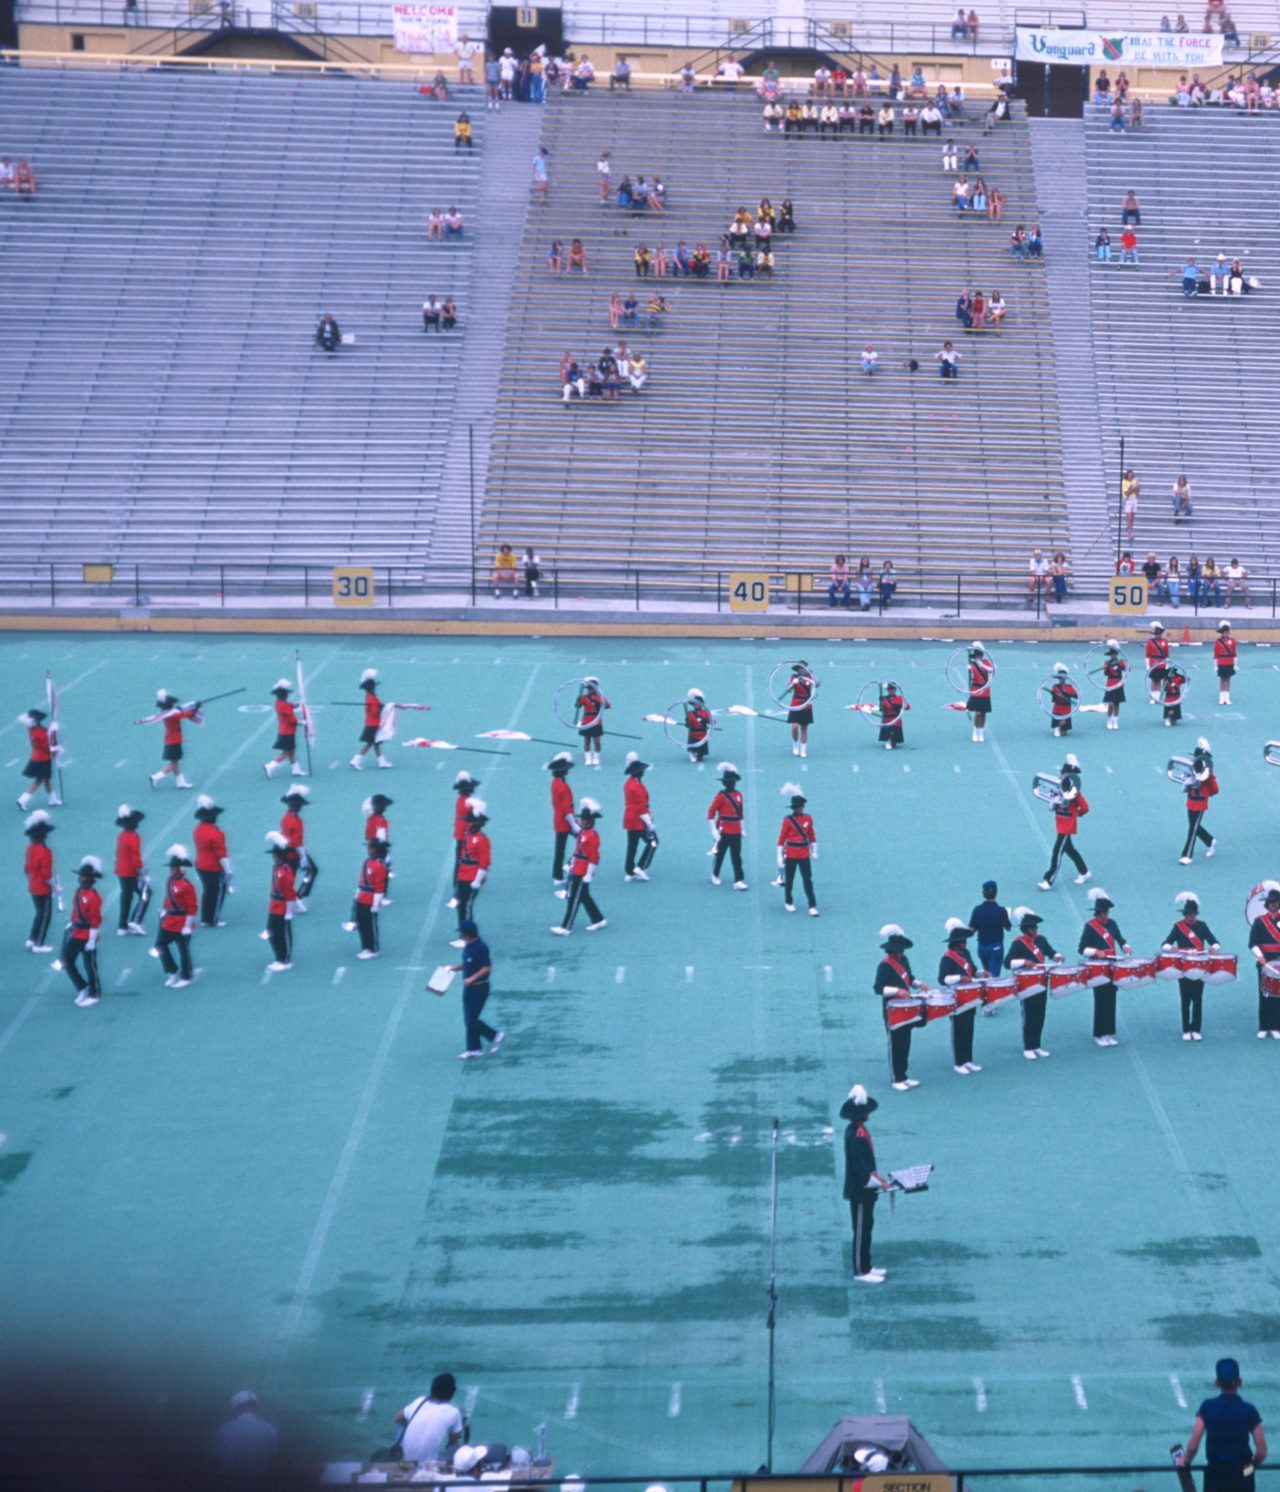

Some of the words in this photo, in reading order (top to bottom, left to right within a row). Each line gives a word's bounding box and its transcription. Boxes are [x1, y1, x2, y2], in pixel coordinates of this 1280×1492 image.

[394, 6, 454, 16] WELCOME
[521, 10, 532, 24] 11
[1029, 34, 1095, 59] Vanguard
[1179, 36, 1211, 48] FORCE
[338, 576, 368, 597] 30
[734, 582, 764, 602] 40
[1114, 585, 1143, 606] 50
